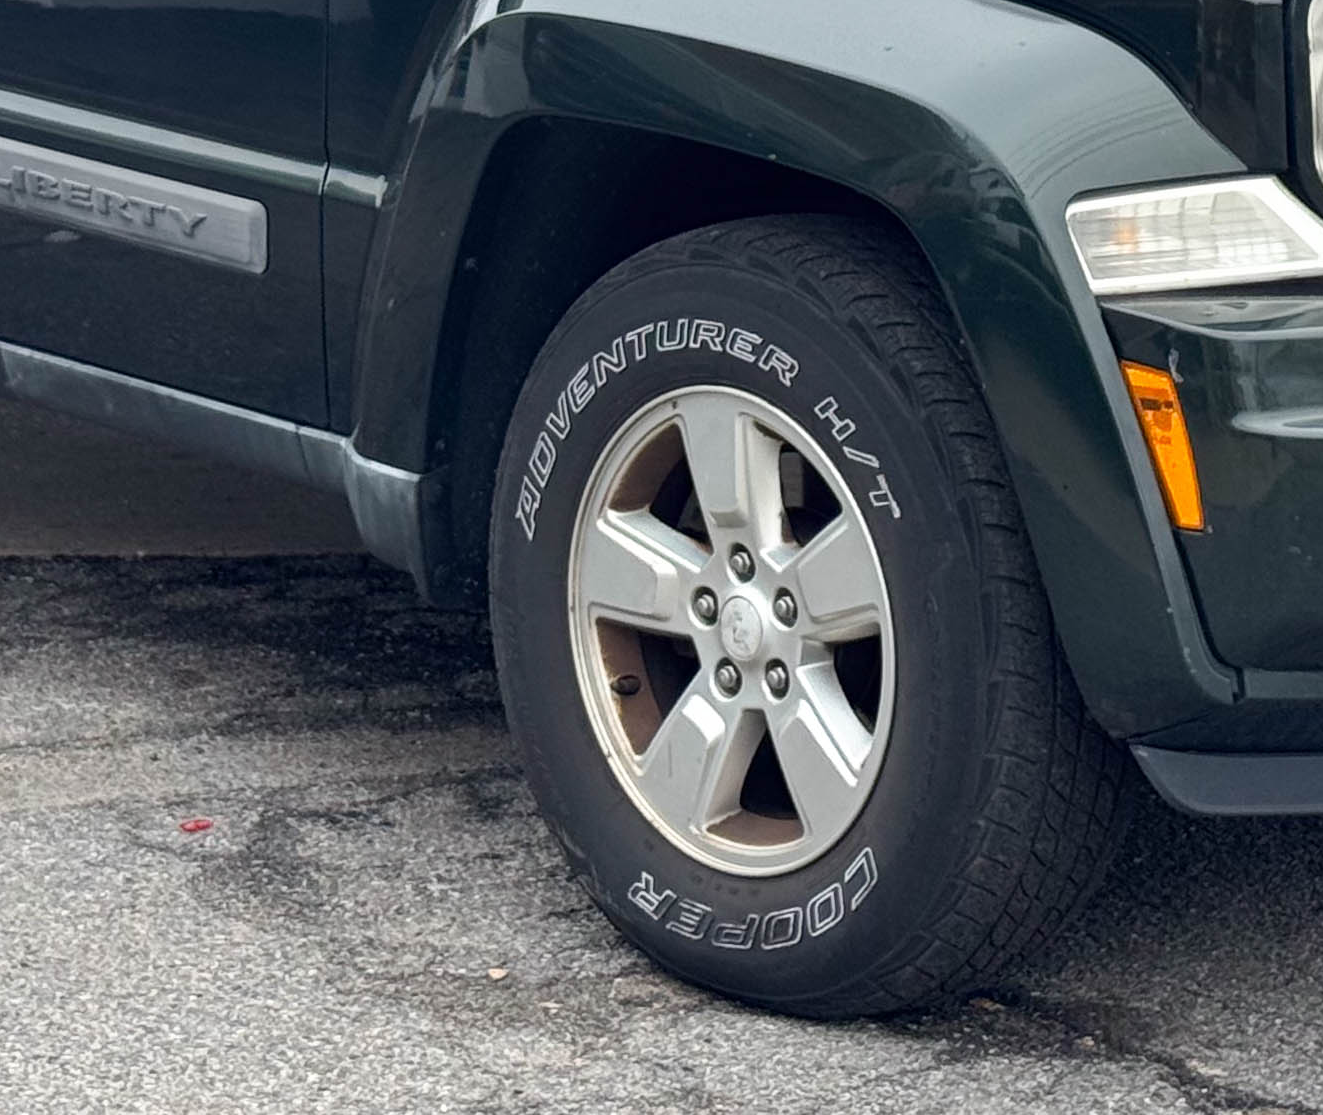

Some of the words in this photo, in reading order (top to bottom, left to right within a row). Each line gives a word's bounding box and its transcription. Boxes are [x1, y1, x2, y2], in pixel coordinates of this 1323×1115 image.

[515, 318, 800, 542] ADVENTURER
[814, 396, 901, 519] H/T
[627, 846, 879, 951] COOPER
